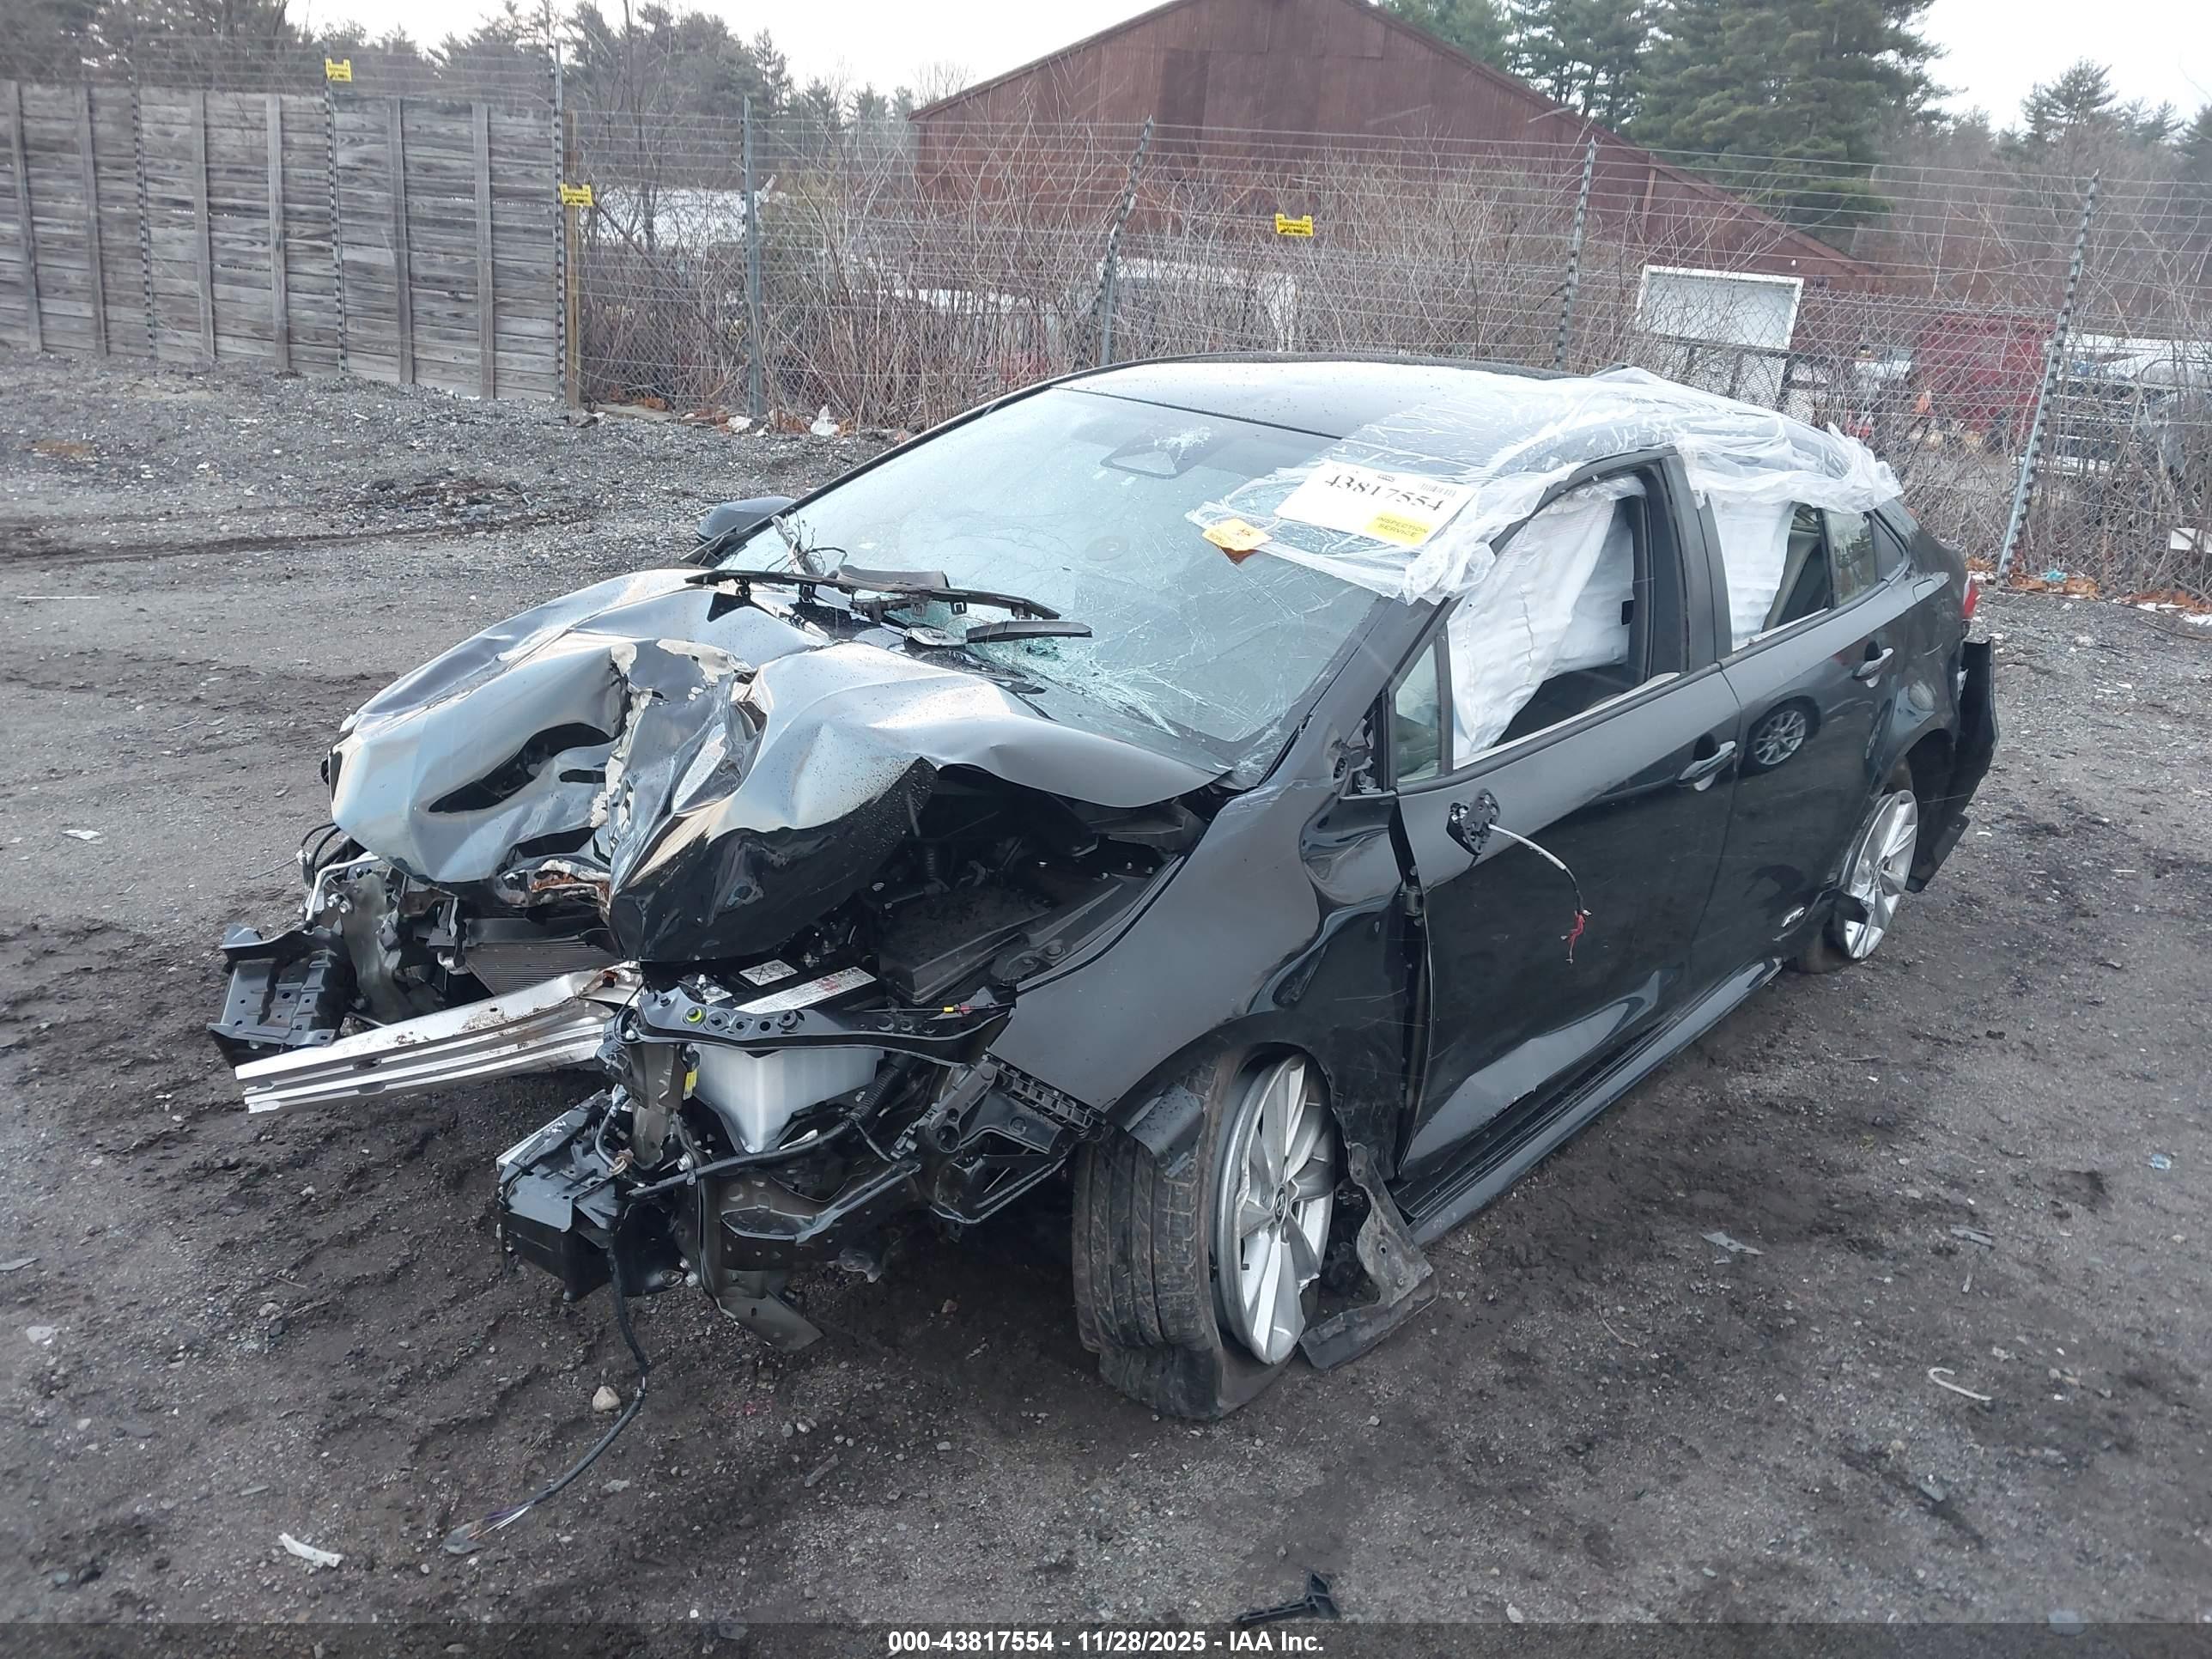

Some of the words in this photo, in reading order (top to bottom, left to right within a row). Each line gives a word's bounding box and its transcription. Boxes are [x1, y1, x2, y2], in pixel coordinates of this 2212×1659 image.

[1325, 474, 1444, 511] 43817554
[1376, 516, 1429, 533] INSPECTION
[1377, 523, 1417, 538] SERVICE
